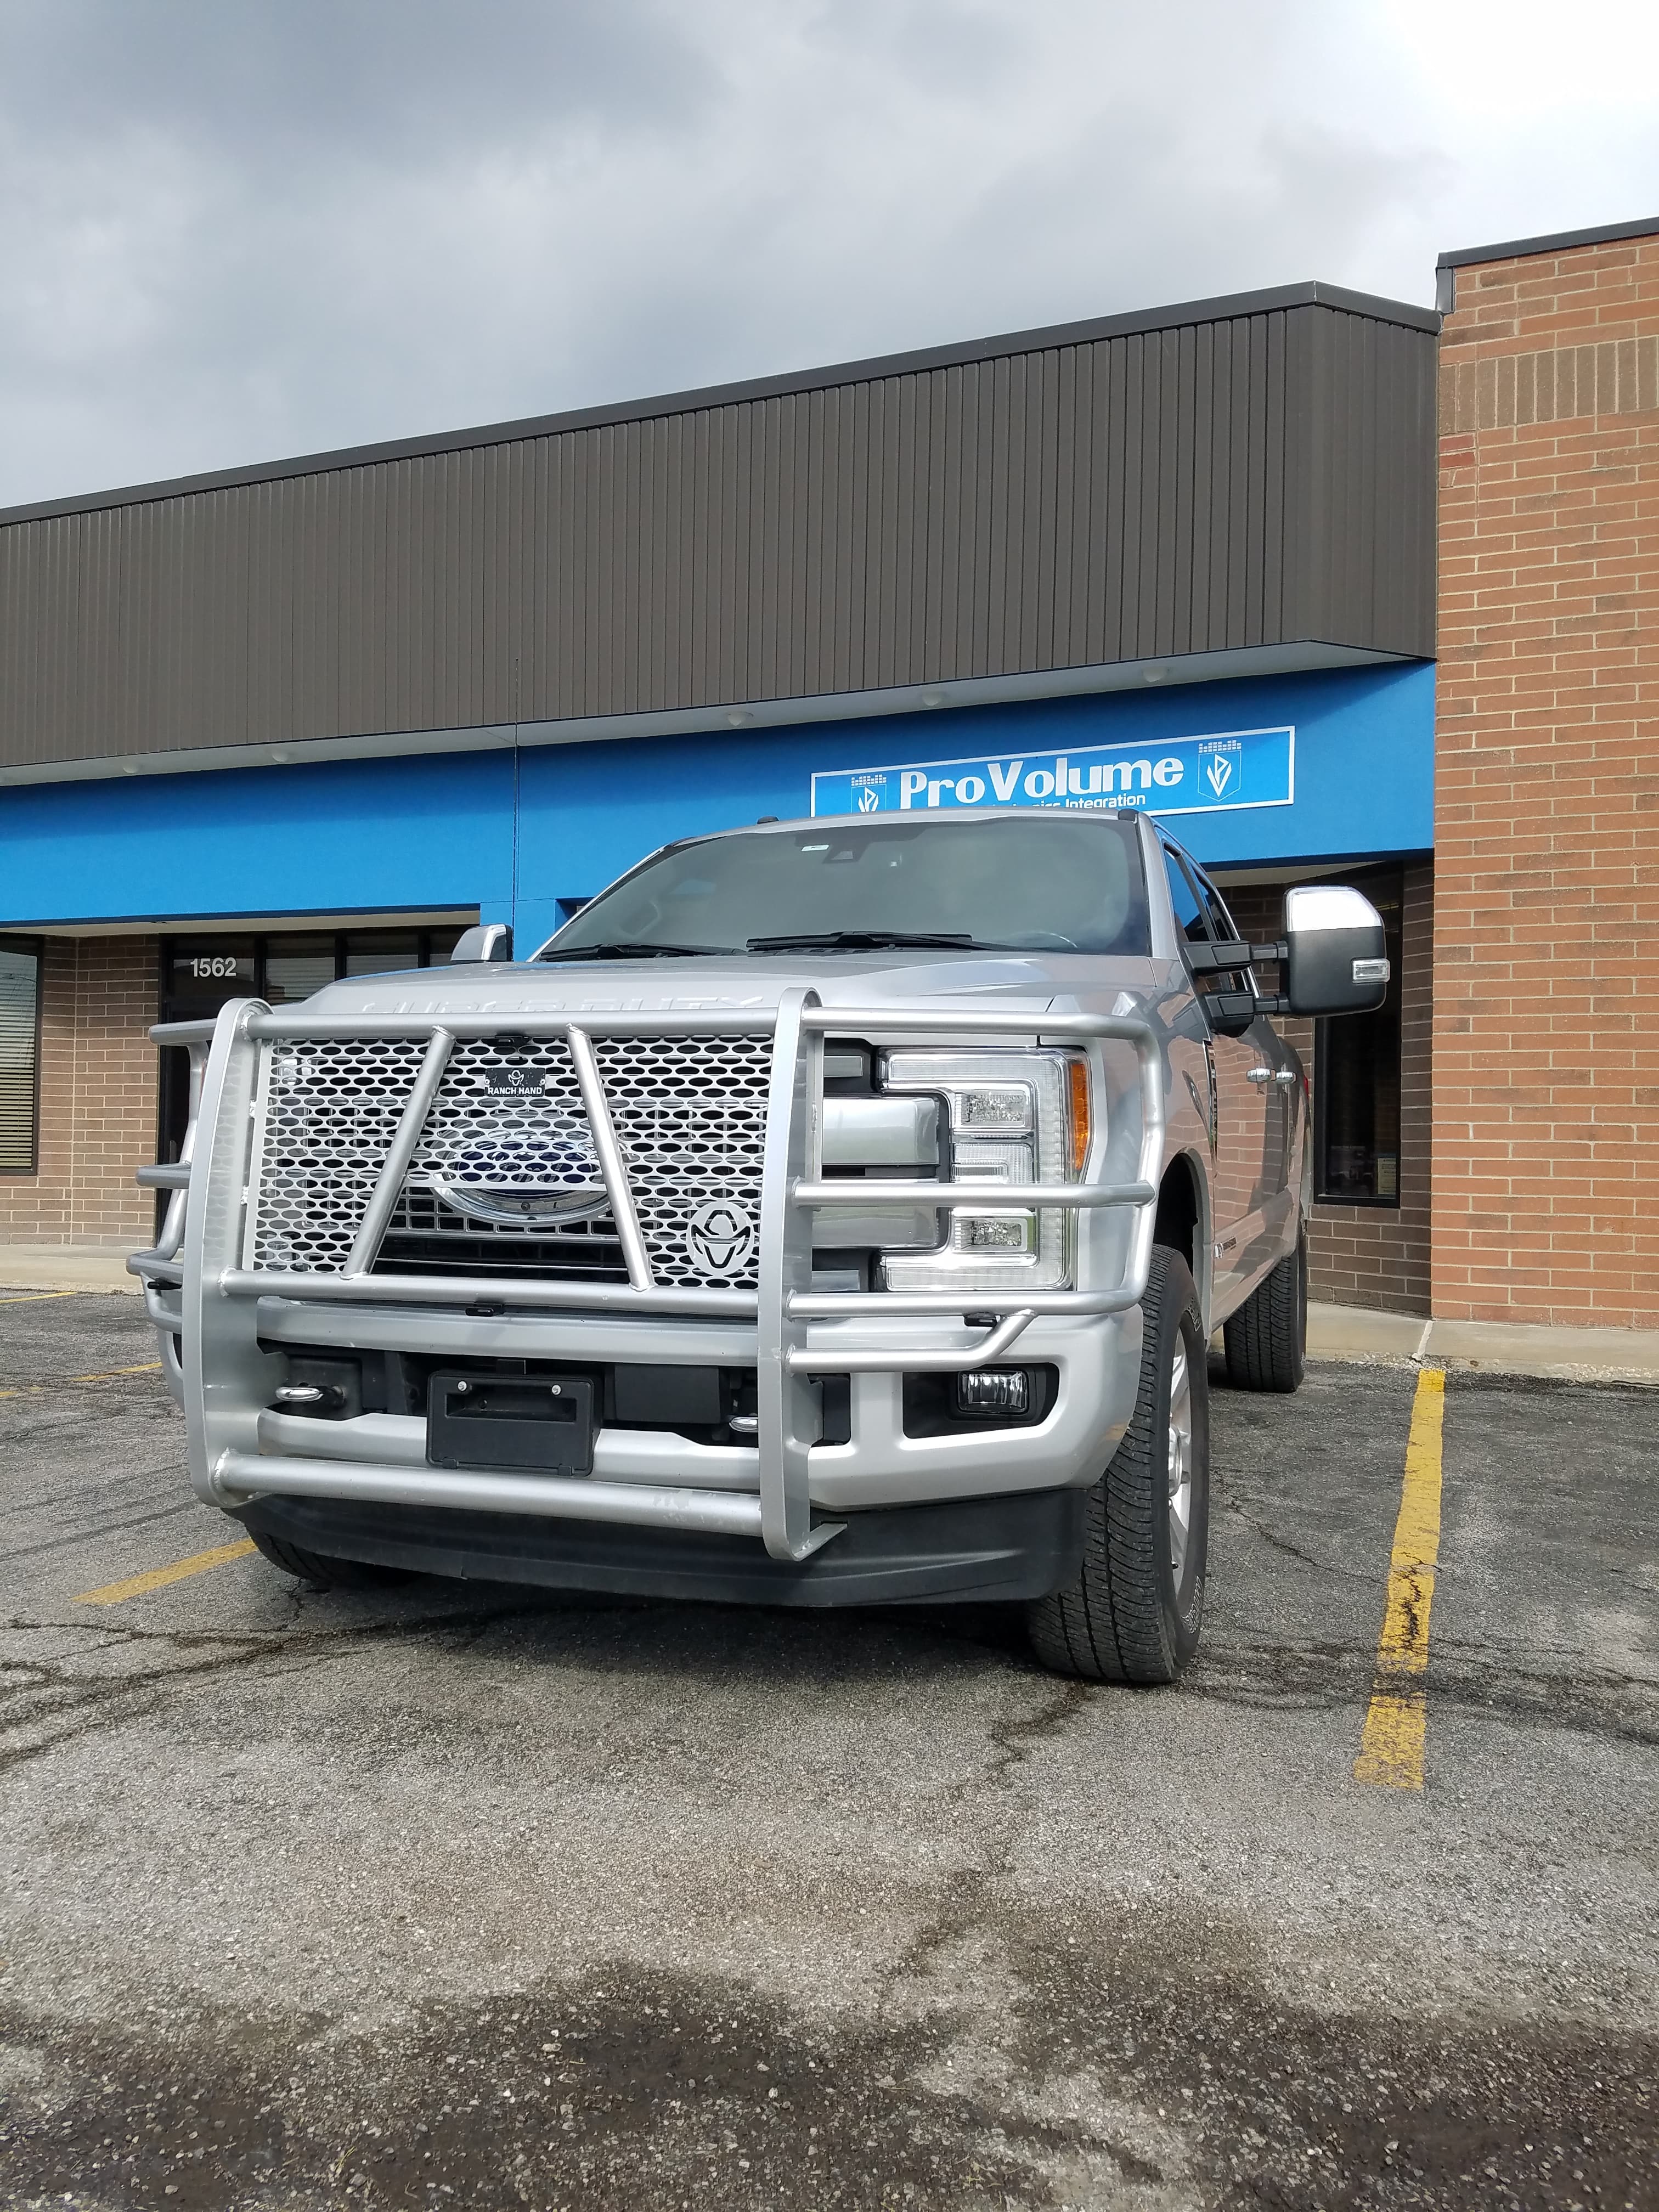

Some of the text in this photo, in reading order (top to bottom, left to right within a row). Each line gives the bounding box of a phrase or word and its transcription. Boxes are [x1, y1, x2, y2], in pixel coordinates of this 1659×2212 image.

[900, 757, 1184, 810] ProVolume
[190, 957, 236, 977] 1562
[488, 1086, 543, 1094] RANCH HAND
